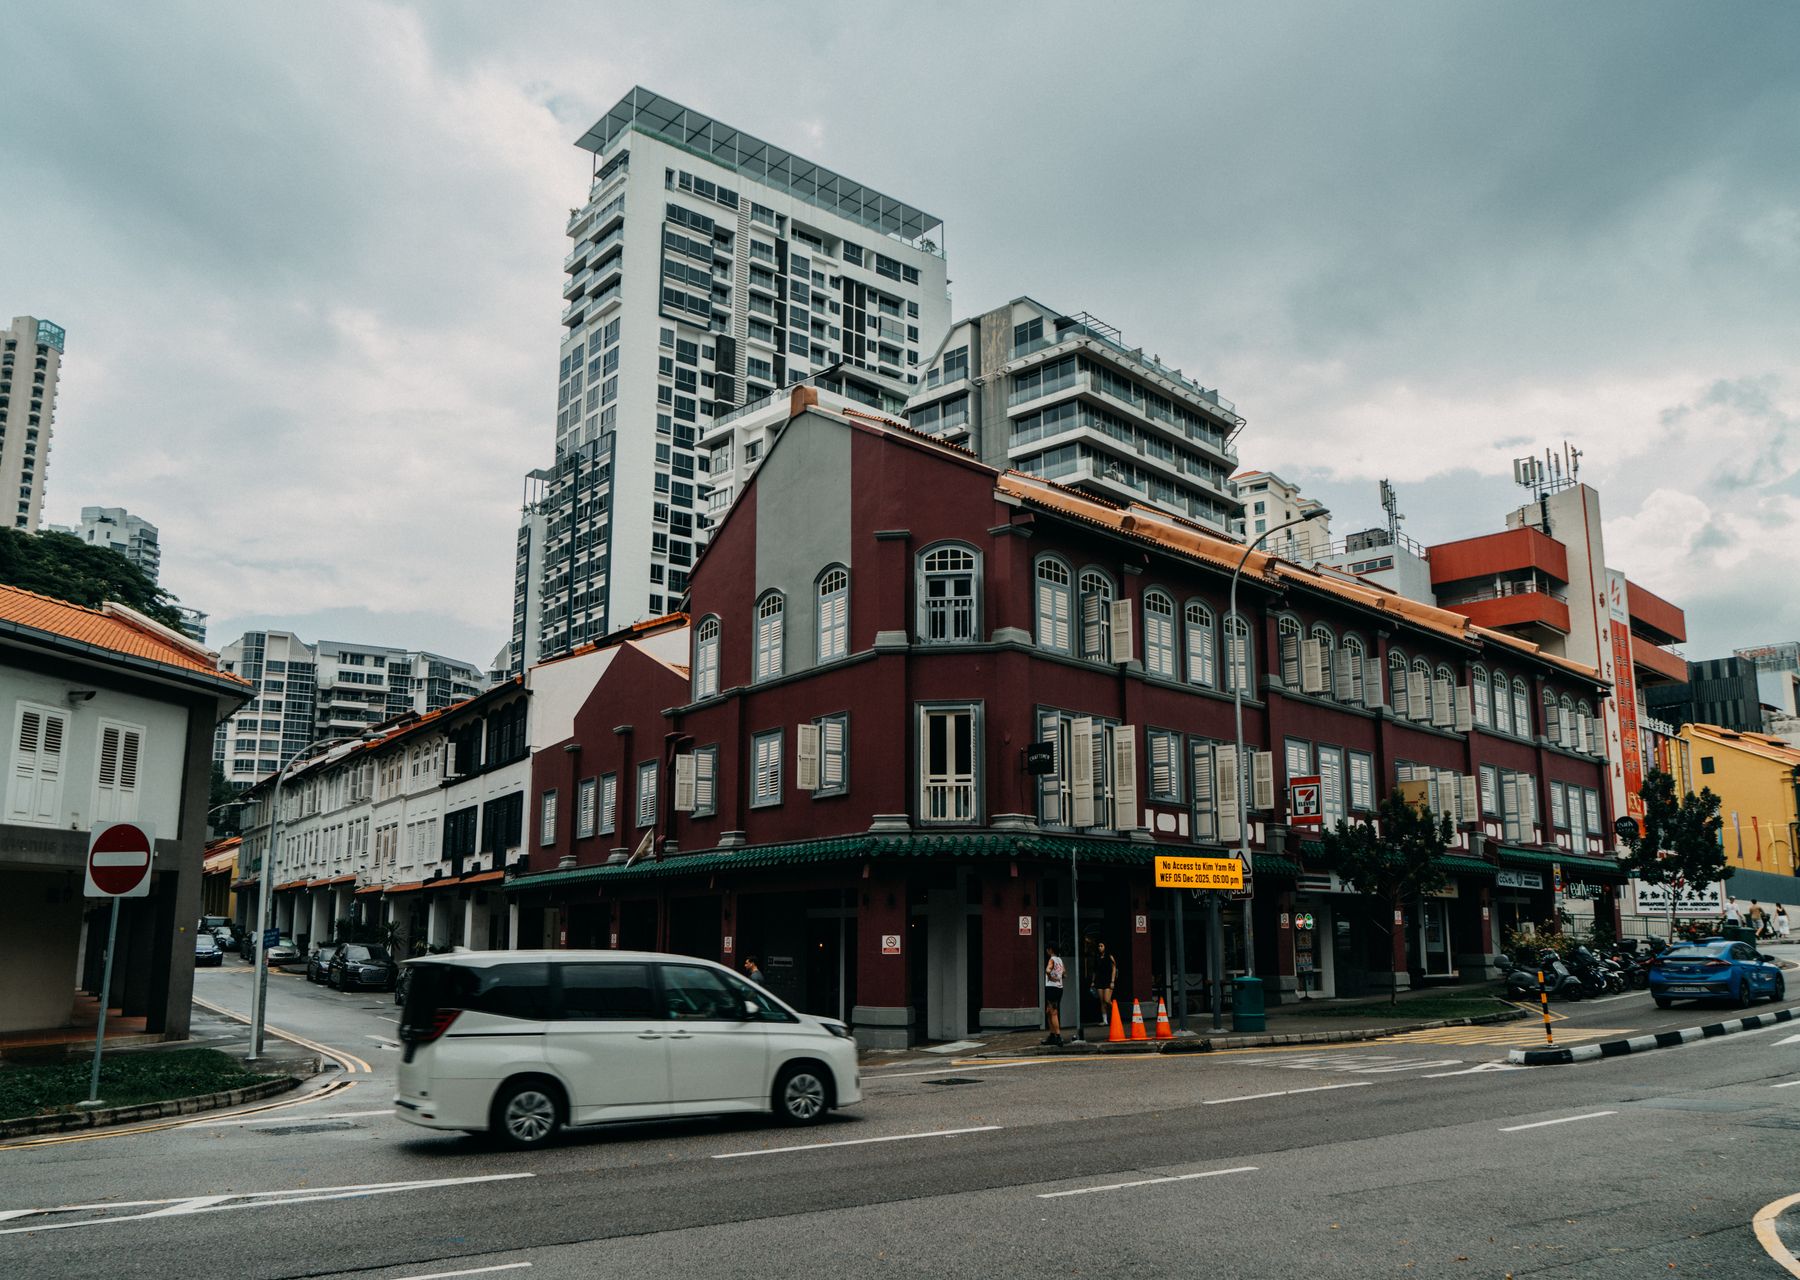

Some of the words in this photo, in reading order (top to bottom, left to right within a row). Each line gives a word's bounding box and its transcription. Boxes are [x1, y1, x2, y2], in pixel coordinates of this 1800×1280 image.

[1298, 789, 1315, 814] 7
[1162, 861, 1171, 870] No
[1172, 861, 1194, 871] Access
[1195, 862, 1202, 871] to
[1202, 862, 1214, 871] Kim
[1214, 862, 1228, 872] Yam
[1228, 863, 1236, 872] Rd
[1159, 873, 1172, 882] WEF
[1173, 873, 1182, 883] 05
[1182, 874, 1194, 883] Dec
[1212, 874, 1229, 884] 05:00
[1230, 876, 1240, 886] pm
